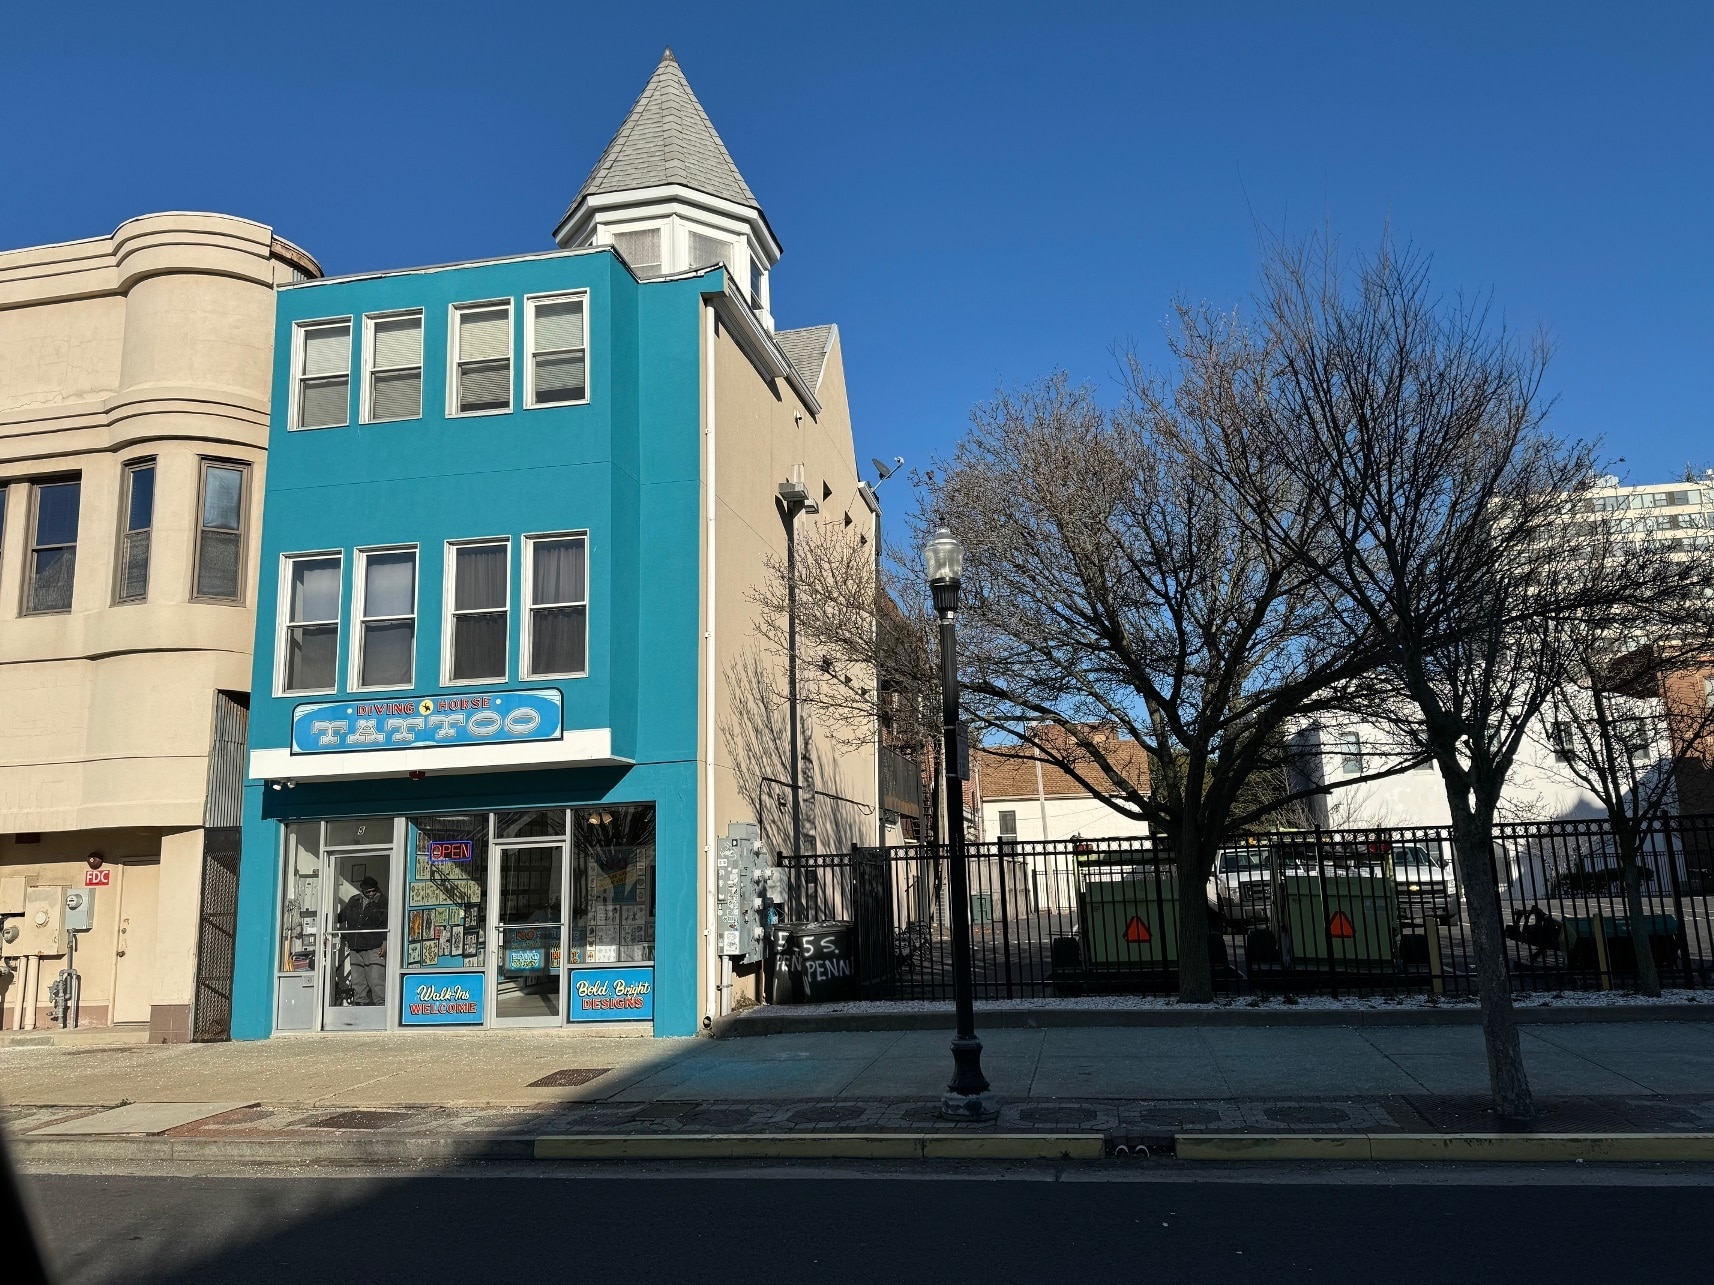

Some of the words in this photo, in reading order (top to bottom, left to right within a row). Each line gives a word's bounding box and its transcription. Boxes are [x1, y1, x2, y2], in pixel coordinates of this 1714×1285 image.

[356, 701, 416, 716] DIVING
[436, 696, 491, 712] HORSE
[312, 707, 541, 745] TATTOO
[431, 843, 471, 859] OPEN
[86, 870, 109, 884] FDC
[802, 936, 815, 957] 5
[820, 936, 840, 954] S.
[417, 984, 470, 1001] Walk-Ins
[613, 979, 651, 998] Bright
[409, 1002, 477, 1015] WELCOME
[582, 997, 644, 1010] DESIGNS
